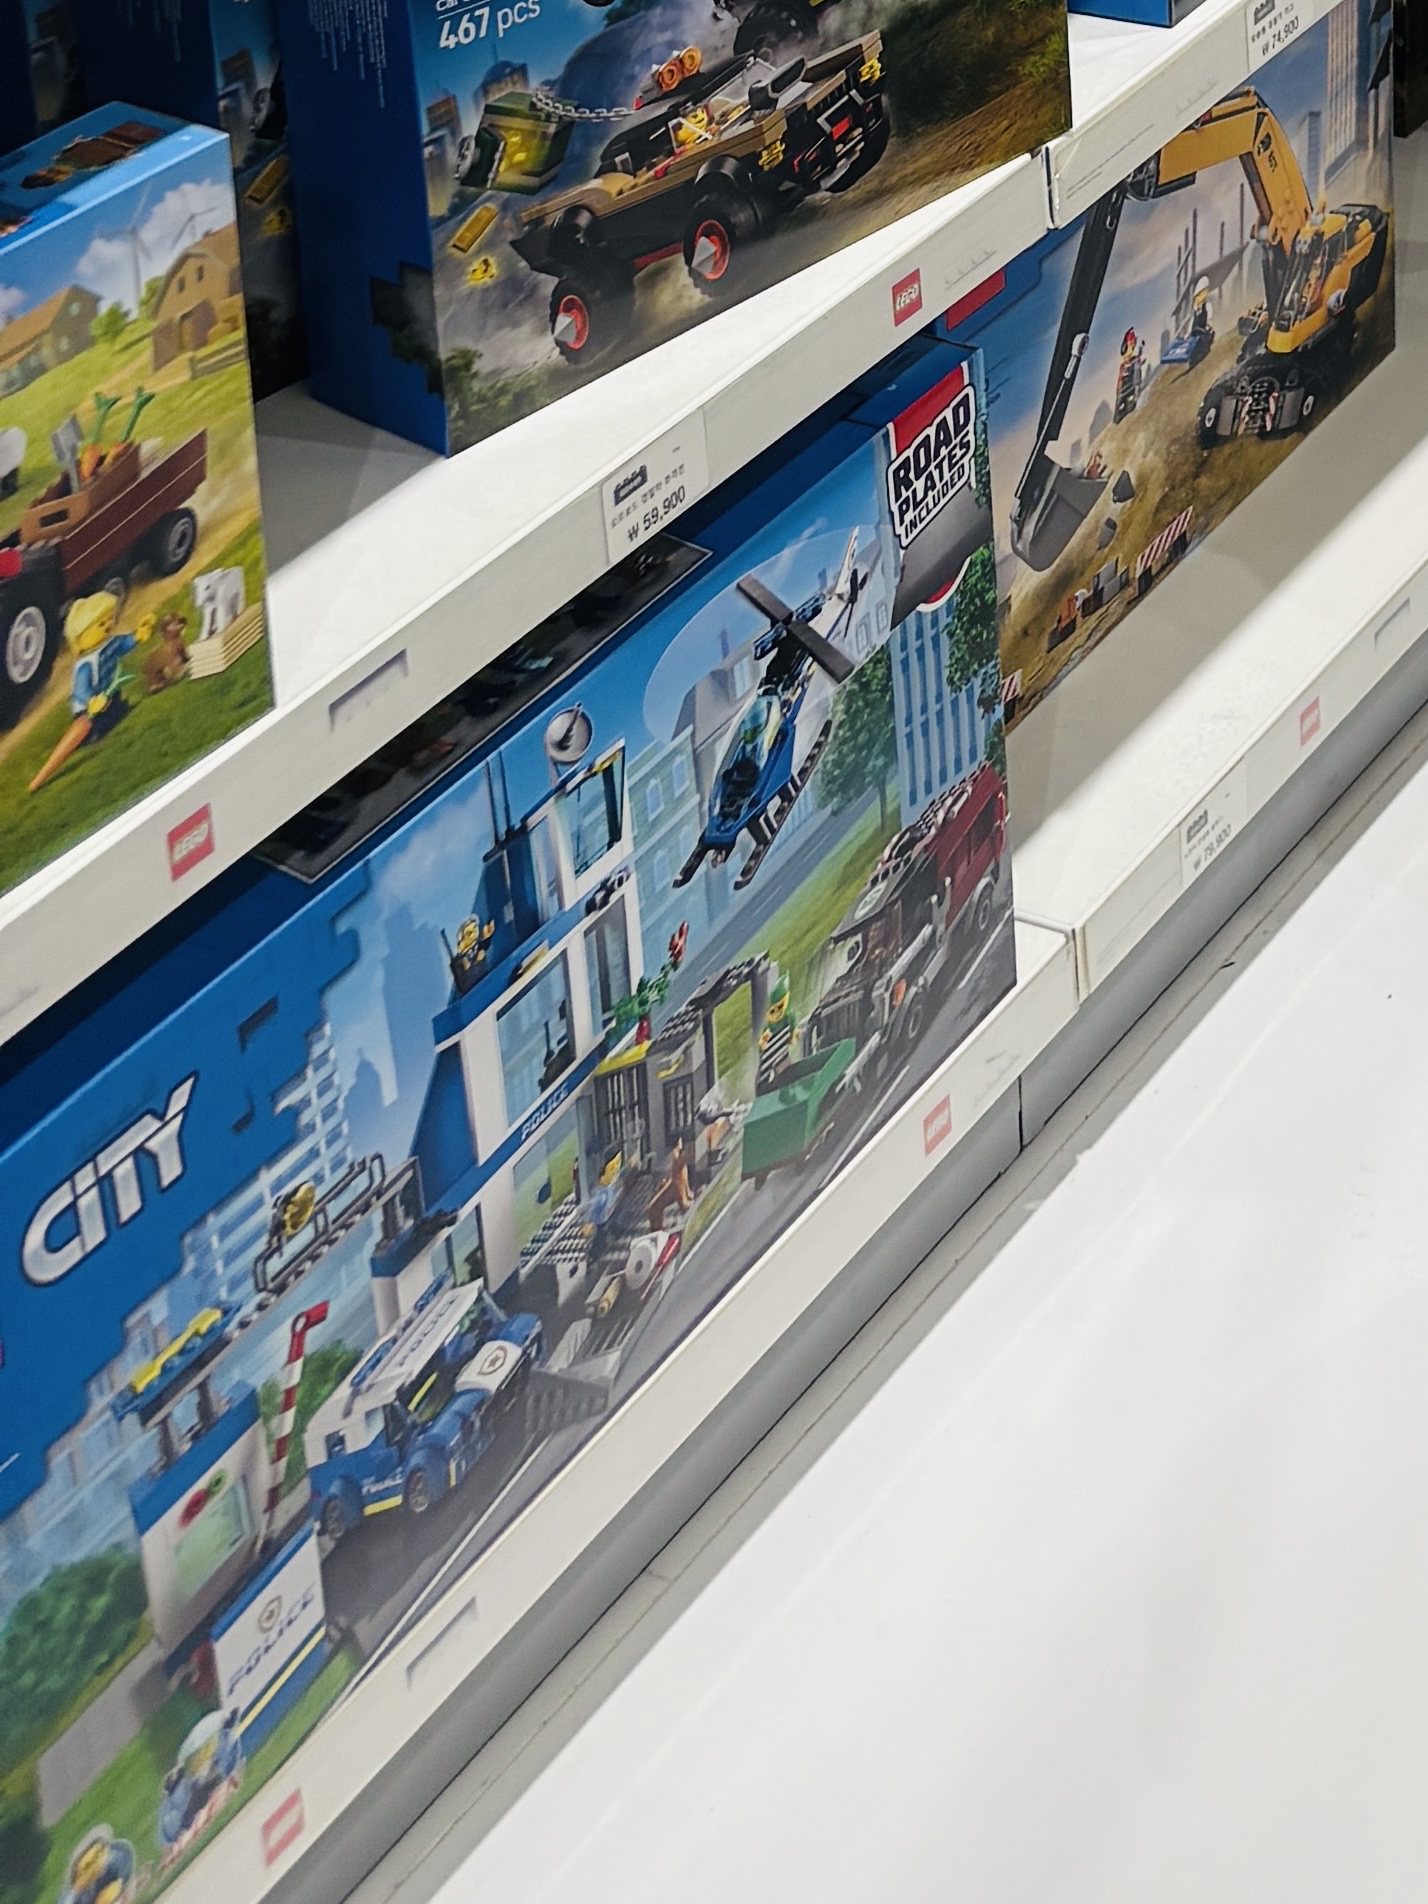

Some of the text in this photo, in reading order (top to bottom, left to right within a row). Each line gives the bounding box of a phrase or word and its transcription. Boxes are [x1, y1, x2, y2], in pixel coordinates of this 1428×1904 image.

[439, 10, 489, 49] 467
[892, 393, 970, 503] ROAD
[898, 429, 970, 526] PLATES
[904, 462, 965, 539] INCLUDED
